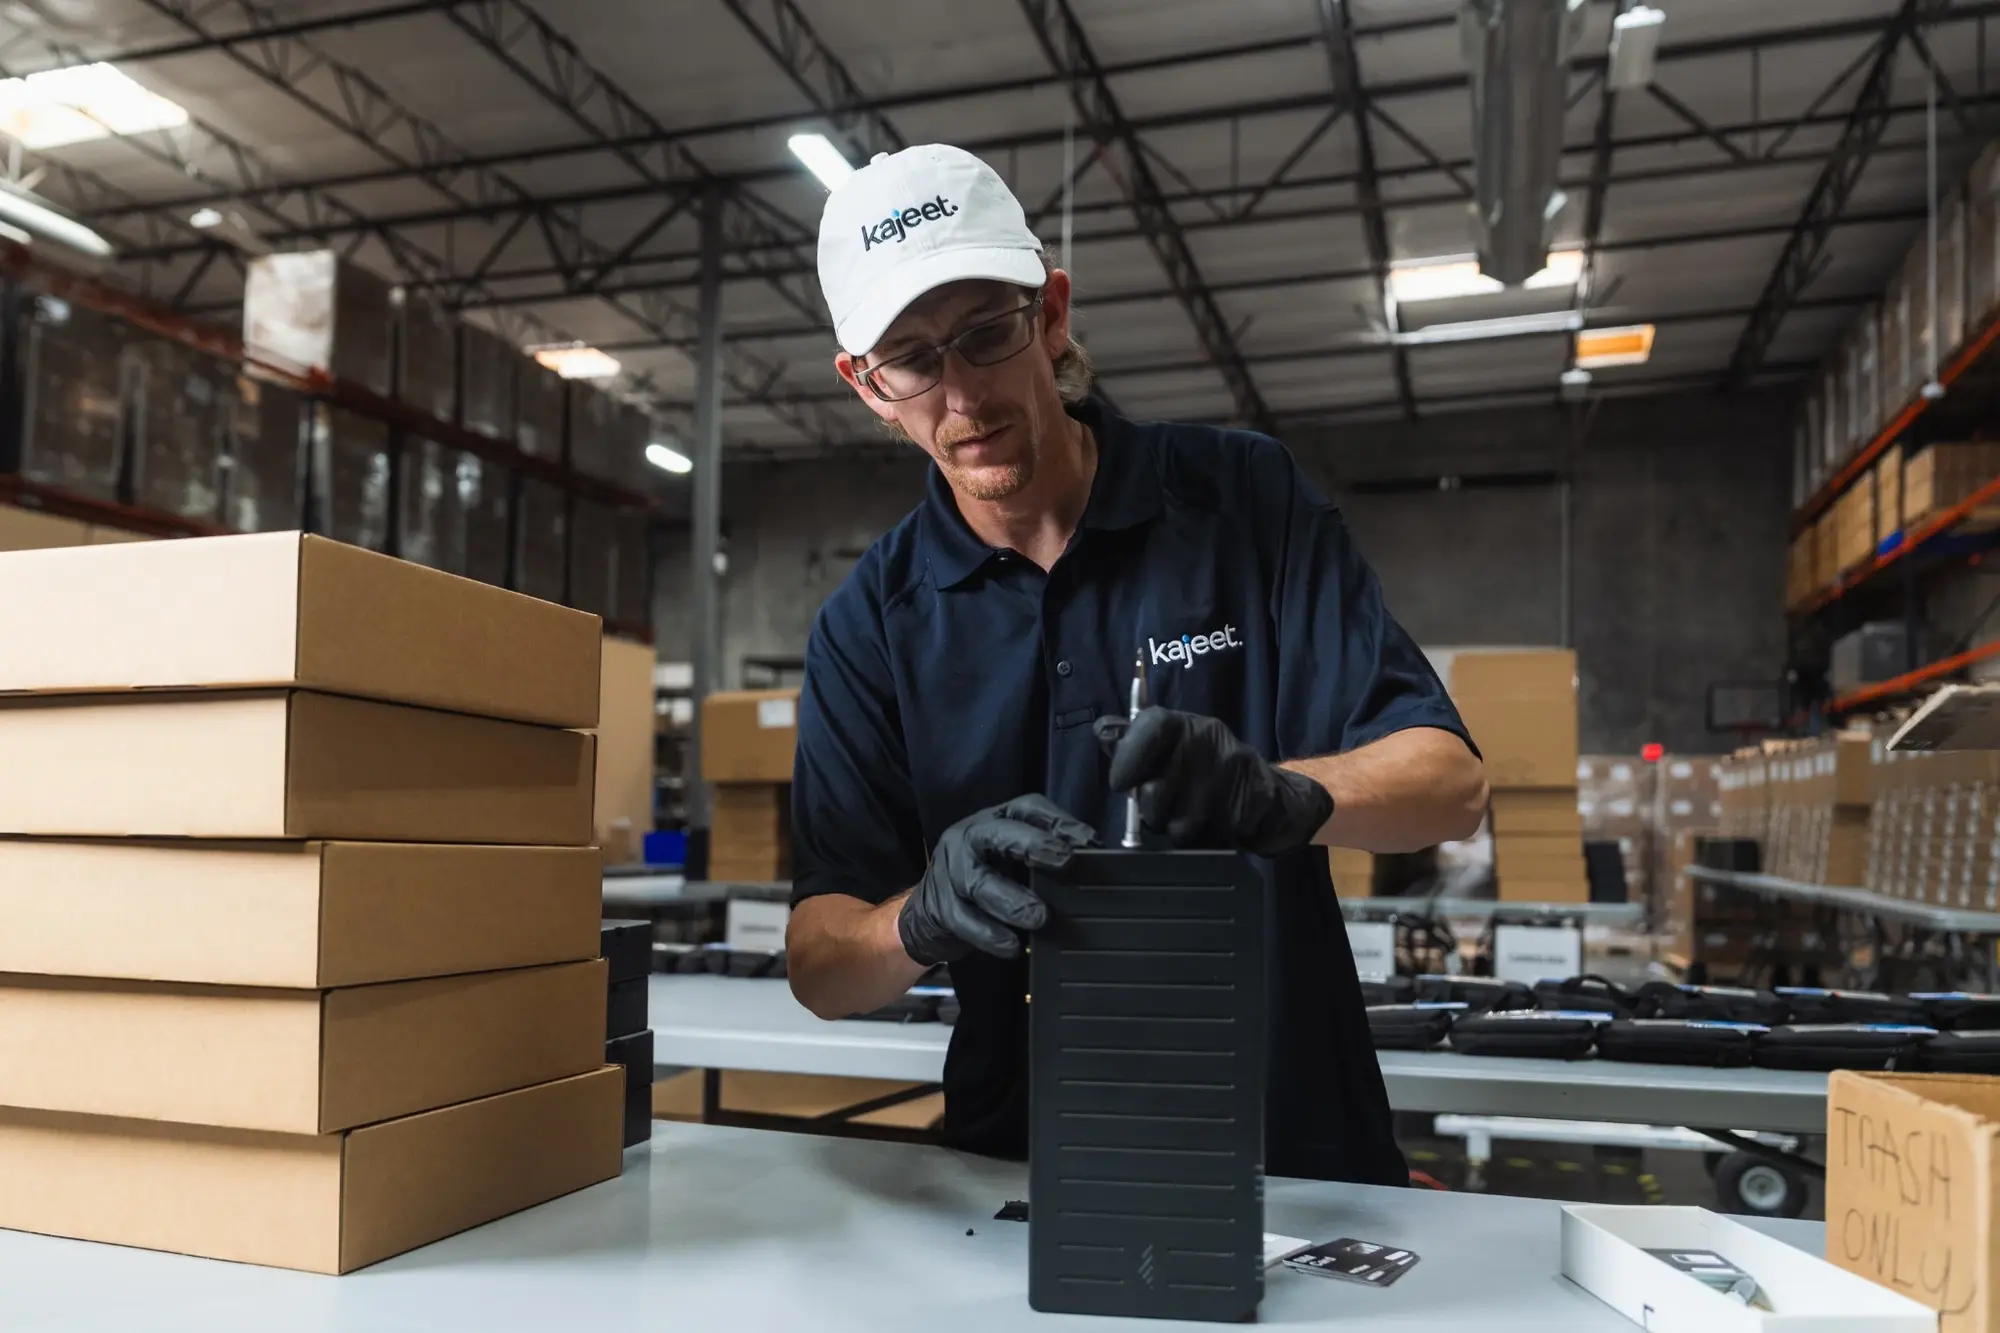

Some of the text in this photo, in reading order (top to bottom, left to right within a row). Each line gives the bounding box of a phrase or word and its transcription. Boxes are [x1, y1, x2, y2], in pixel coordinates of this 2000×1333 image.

[861, 194, 959, 252] kajeet.
[1148, 623, 1243, 669] kajeet.
[1835, 1107, 1951, 1222] TRASH
[1842, 1208, 1978, 1316] ONLY
